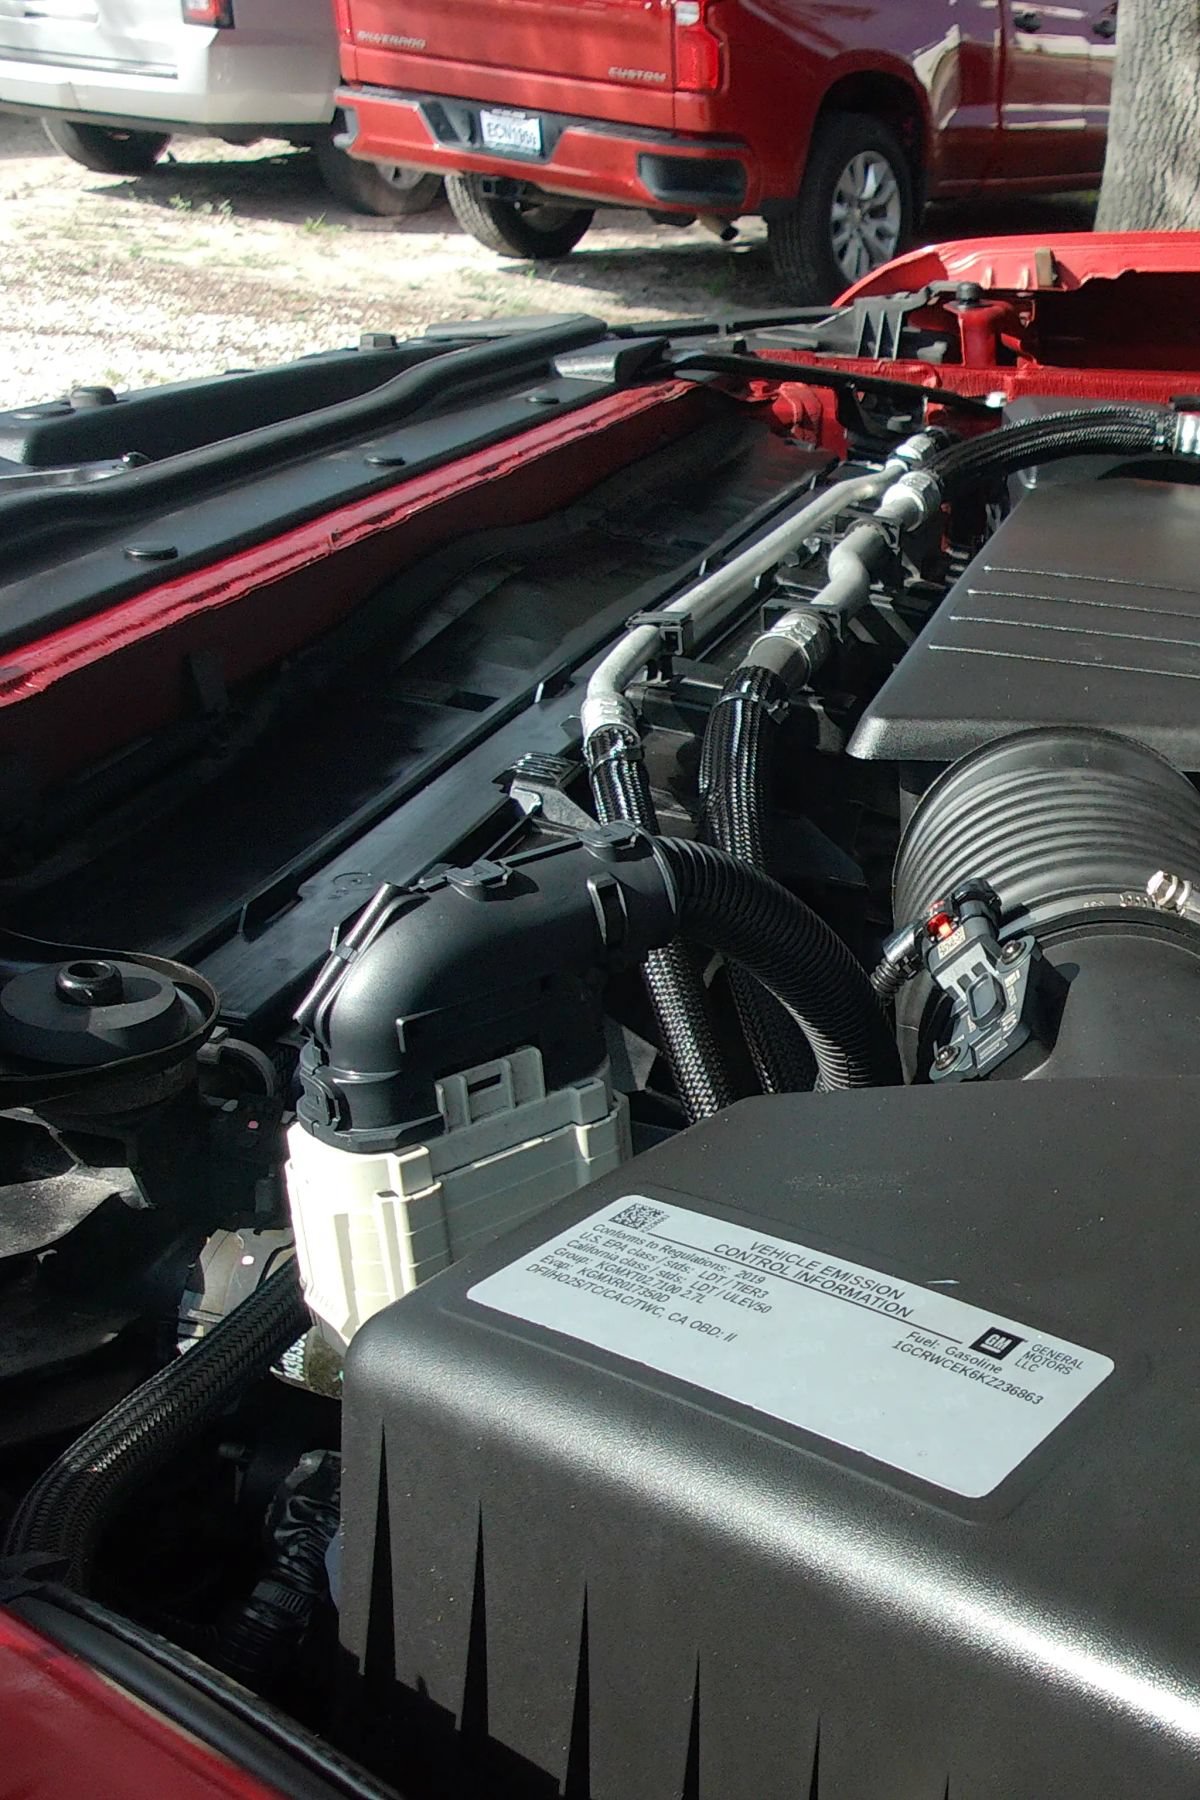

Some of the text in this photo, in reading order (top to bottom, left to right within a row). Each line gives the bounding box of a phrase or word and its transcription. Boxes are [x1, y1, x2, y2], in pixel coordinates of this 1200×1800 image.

[539, 1254, 574, 1270] Evap:
[553, 1247, 593, 1265] Group:
[679, 1289, 706, 1304] 2.7L
[579, 1231, 602, 1244] U.S.
[602, 1239, 628, 1252] EPA
[627, 1248, 658, 1261] class
[663, 1260, 695, 1274] stds:
[698, 1270, 727, 1284] LDT
[732, 1281, 769, 1299] TIER3
[592, 1223, 646, 1245] Conforms
[645, 1240, 659, 1250] to
[658, 1244, 731, 1273] Regulations:
[734, 1270, 766, 1285] 2019
[750, 1241, 906, 1300] VEHICLE EMISSION
[566, 1239, 620, 1261] California
[619, 1256, 650, 1271] class
[656, 1269, 687, 1284] stds:
[689, 1280, 719, 1294] LDT
[722, 1291, 773, 1314] ULEV50
[713, 1243, 914, 1319] CONTROL INFORMATION
[668, 1312, 688, 1325] CA
[689, 1320, 724, 1338] OBD:
[984, 1333, 1014, 1351] GM
[905, 1331, 1003, 1374] Fuel: Gasoline
[1014, 1358, 1042, 1373] LLC
[1021, 1351, 1073, 1376] MOTORS
[1031, 1343, 1085, 1370] GENERAL
